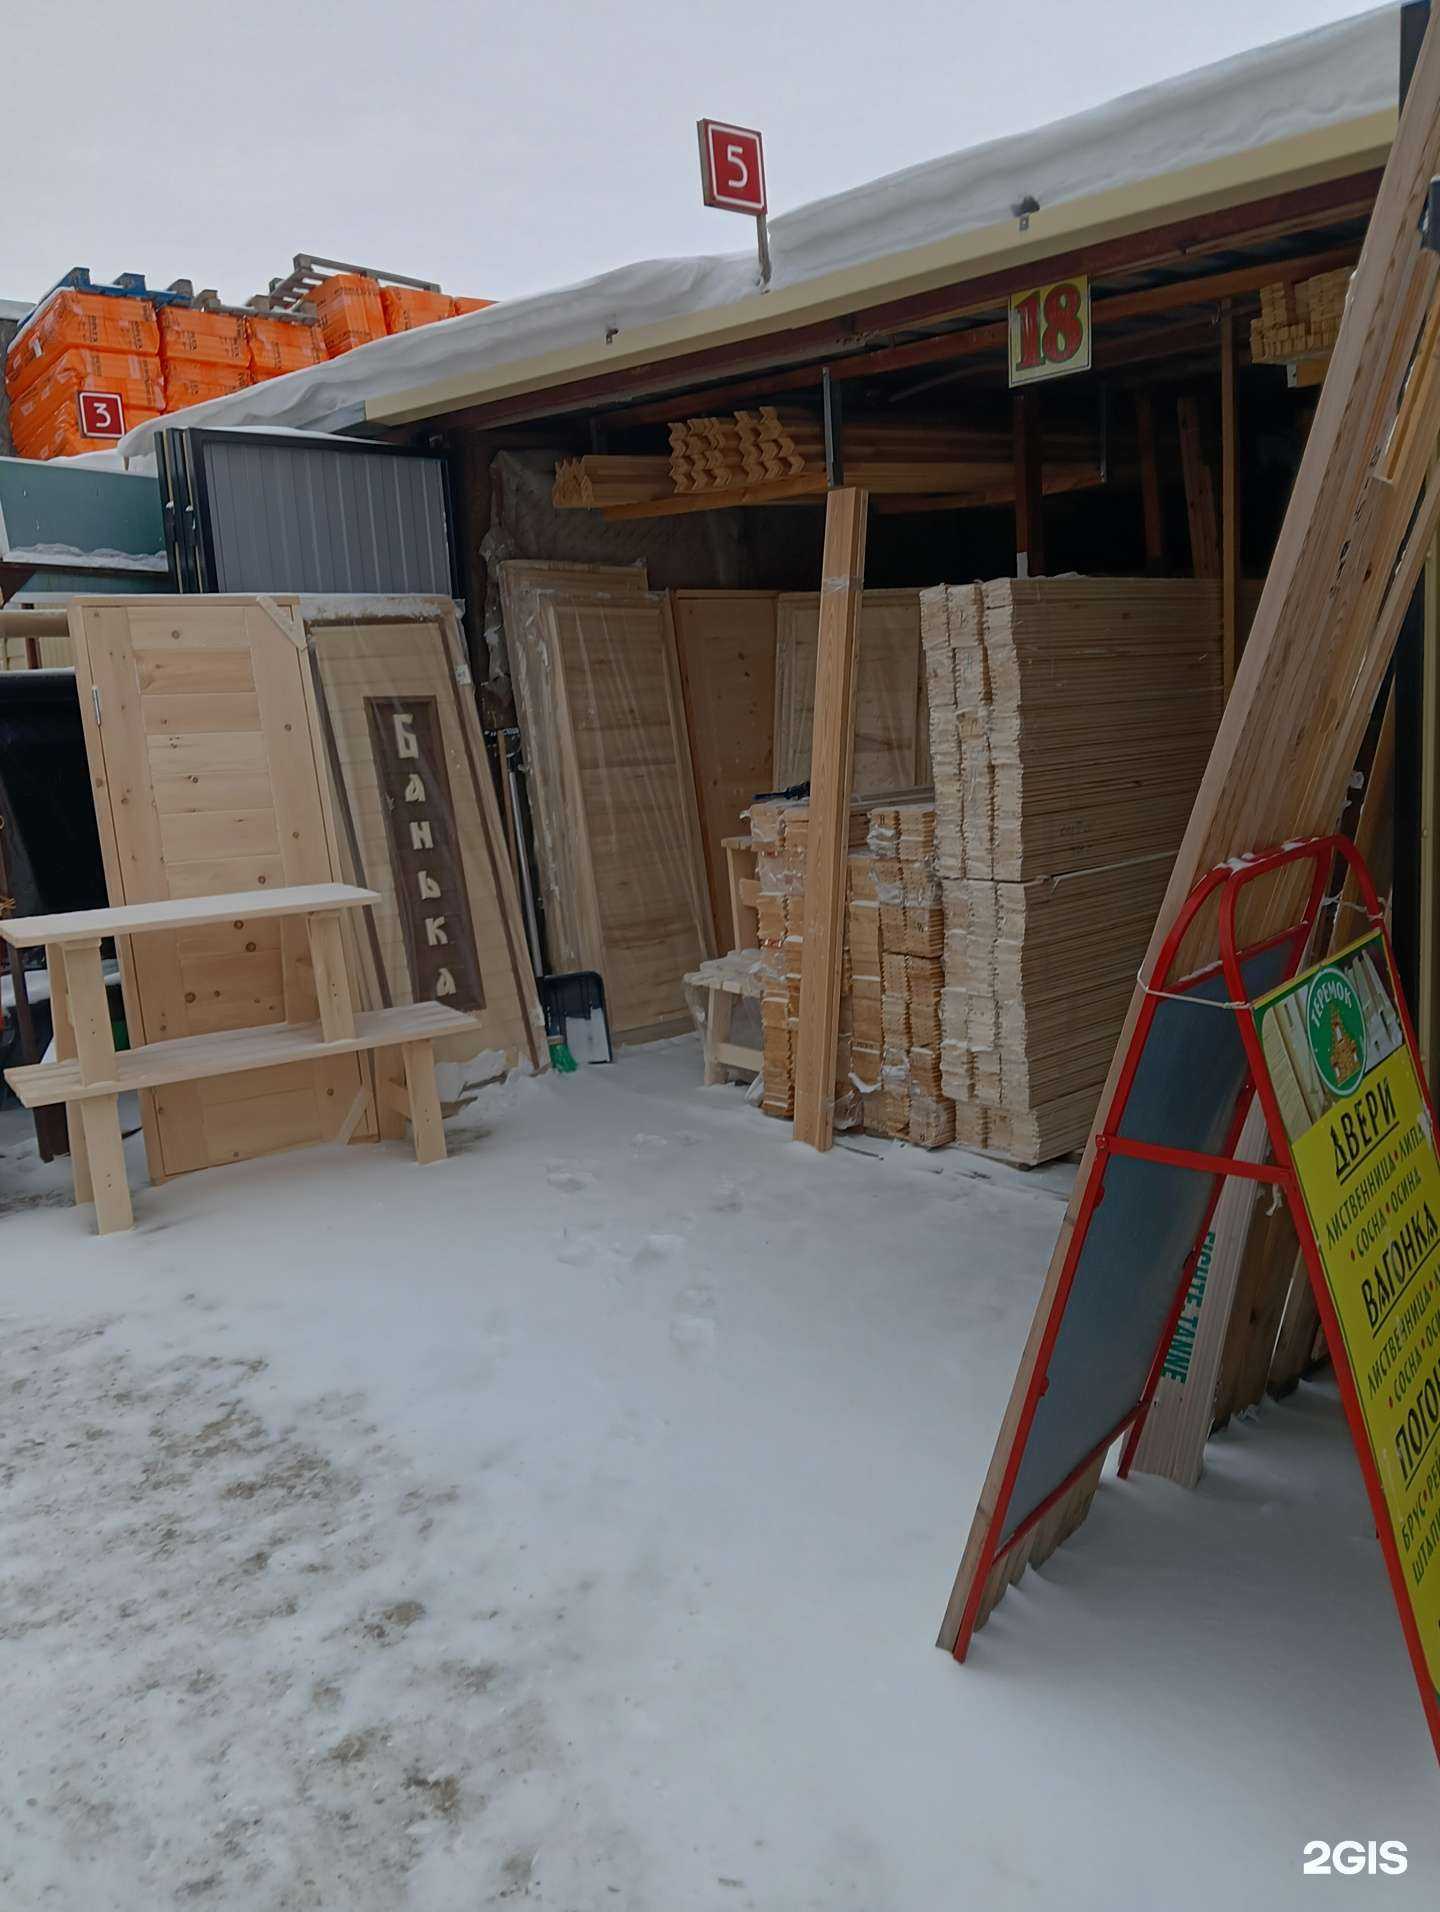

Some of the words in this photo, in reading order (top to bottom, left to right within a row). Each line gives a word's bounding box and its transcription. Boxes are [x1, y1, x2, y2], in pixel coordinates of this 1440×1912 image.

[727, 144, 748, 188] 5
[1015, 283, 1084, 371] 18
[93, 402, 111, 428] 3
[1311, 980, 1352, 1028] ТЕРЕМОК
[1330, 1076, 1396, 1178] ДВЕРИ
[1326, 1152, 1397, 1249] ЛИСТВЕННИЦА
[1356, 1208, 1387, 1258] СОСНА
[1390, 1167, 1422, 1213] ОСИНА
[1361, 1200, 1439, 1329] ВАГОНКА
[1161, 1315, 1199, 1384] TANNE
[1394, 1346, 1422, 1402] СОСНА
[1402, 1491, 1425, 1552] БРУС
